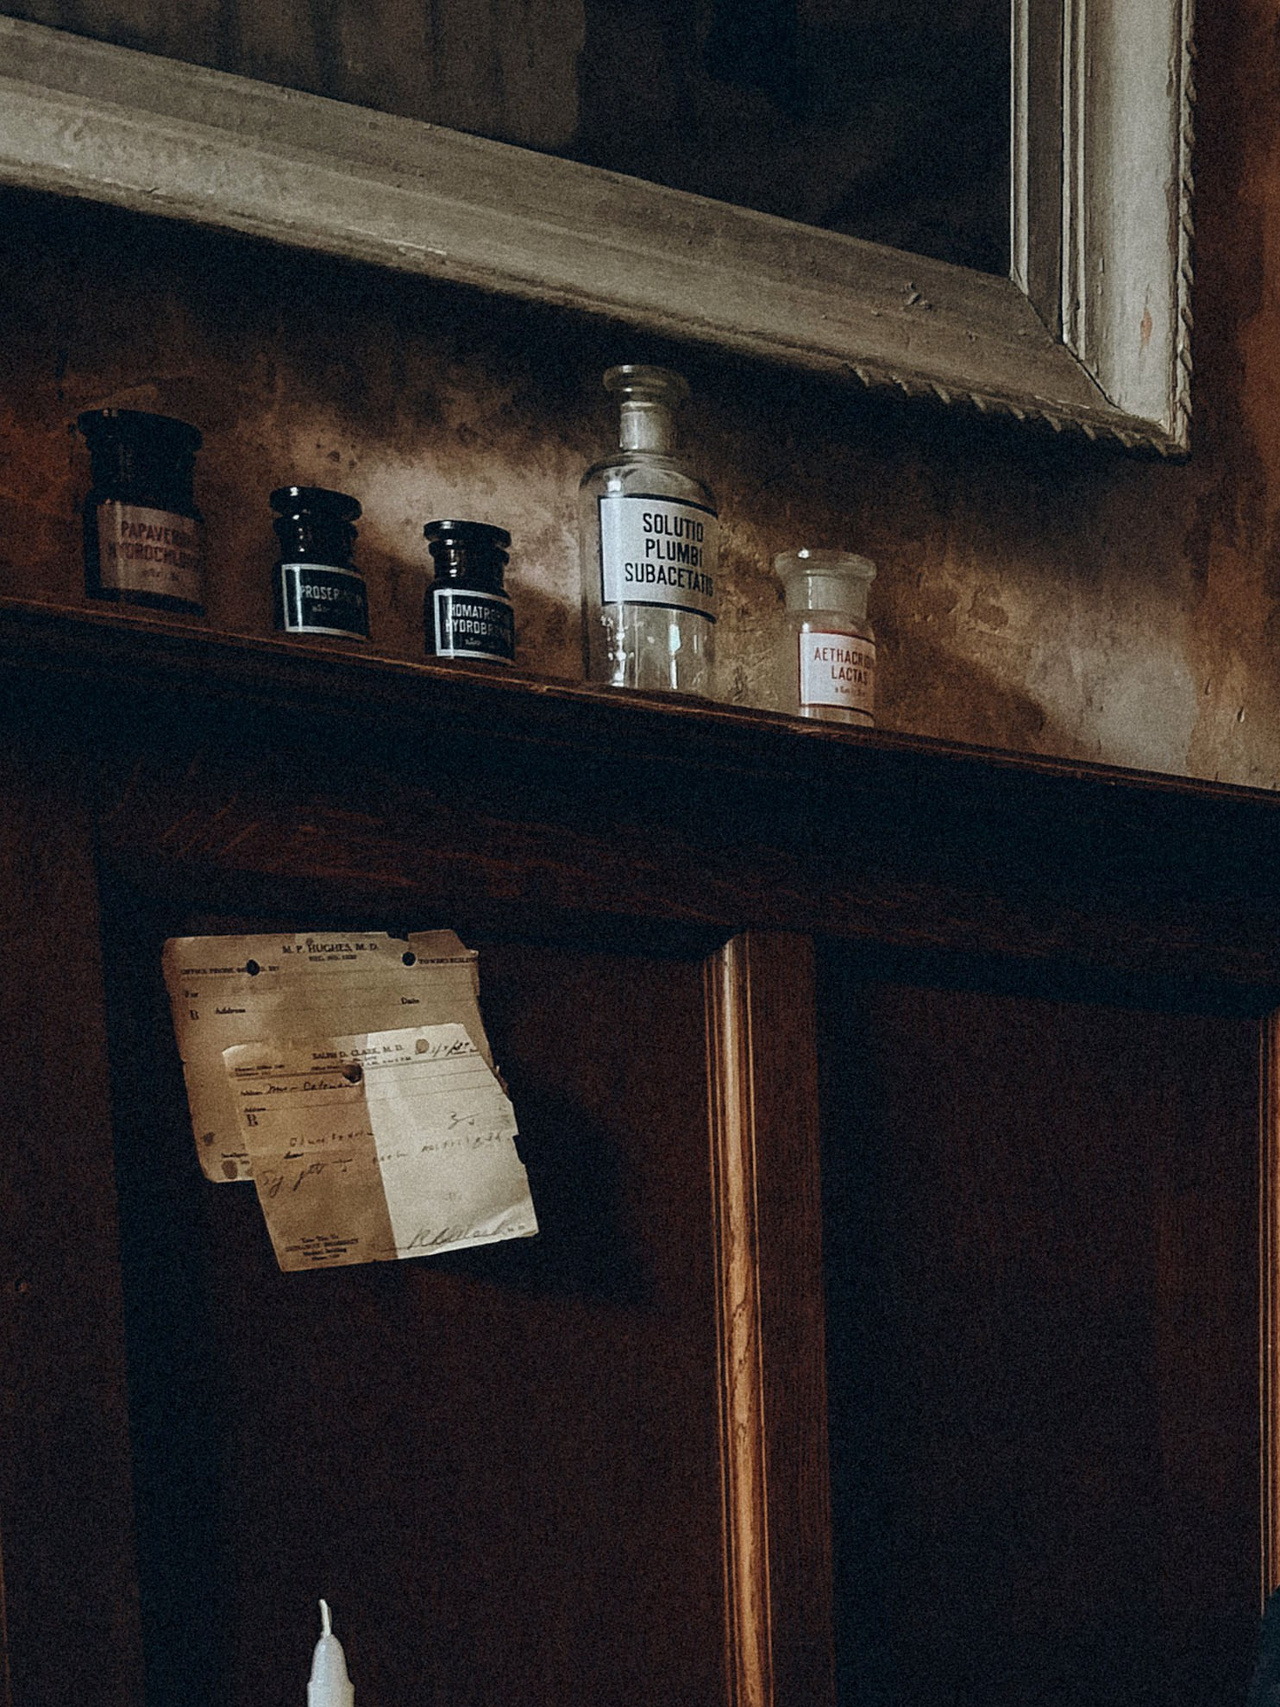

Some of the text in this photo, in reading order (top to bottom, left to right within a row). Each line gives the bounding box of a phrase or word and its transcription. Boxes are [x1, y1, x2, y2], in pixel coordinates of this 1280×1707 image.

[643, 512, 704, 543] SOLUTIO
[645, 538, 703, 568] PLUMBI
[624, 562, 714, 597] SUBACETATIS
